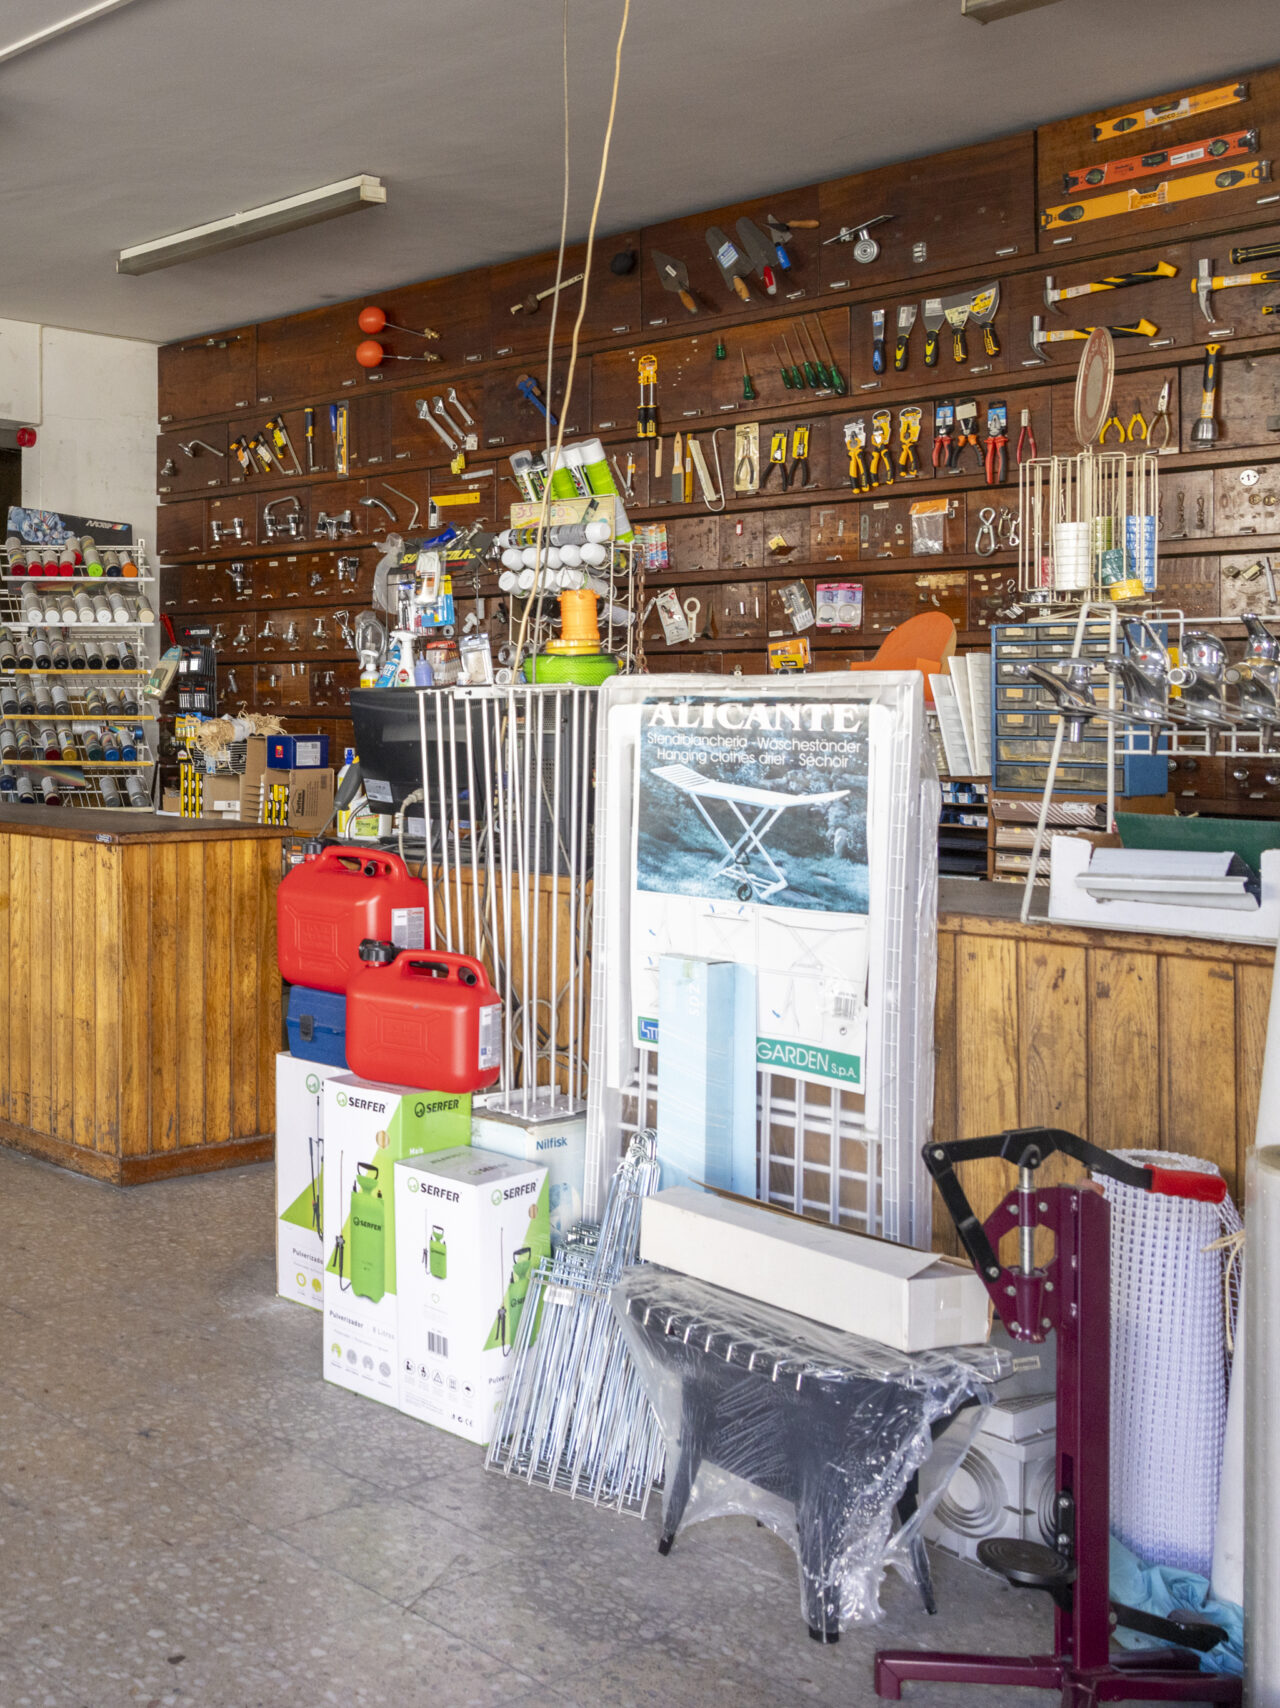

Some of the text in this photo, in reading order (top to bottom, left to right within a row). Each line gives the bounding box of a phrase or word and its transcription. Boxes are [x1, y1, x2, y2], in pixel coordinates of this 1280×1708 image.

[648, 702, 863, 733] ALICANTE
[647, 732, 747, 748] Stendibiancheria
[657, 748, 707, 765] Hanging
[710, 750, 755, 764] clothes
[759, 751, 786, 765] drier
[756, 1041, 857, 1079] GARDEN S.p.A.
[348, 1096, 386, 1114] SERFER
[426, 1099, 460, 1114] SERFER
[536, 1136, 568, 1151] Nilfisk
[420, 1182, 460, 1203] SERFER
[503, 1181, 537, 1200] SERFER
[360, 1219, 382, 1232] SERFER
[292, 1248, 324, 1265] Pulverizado
